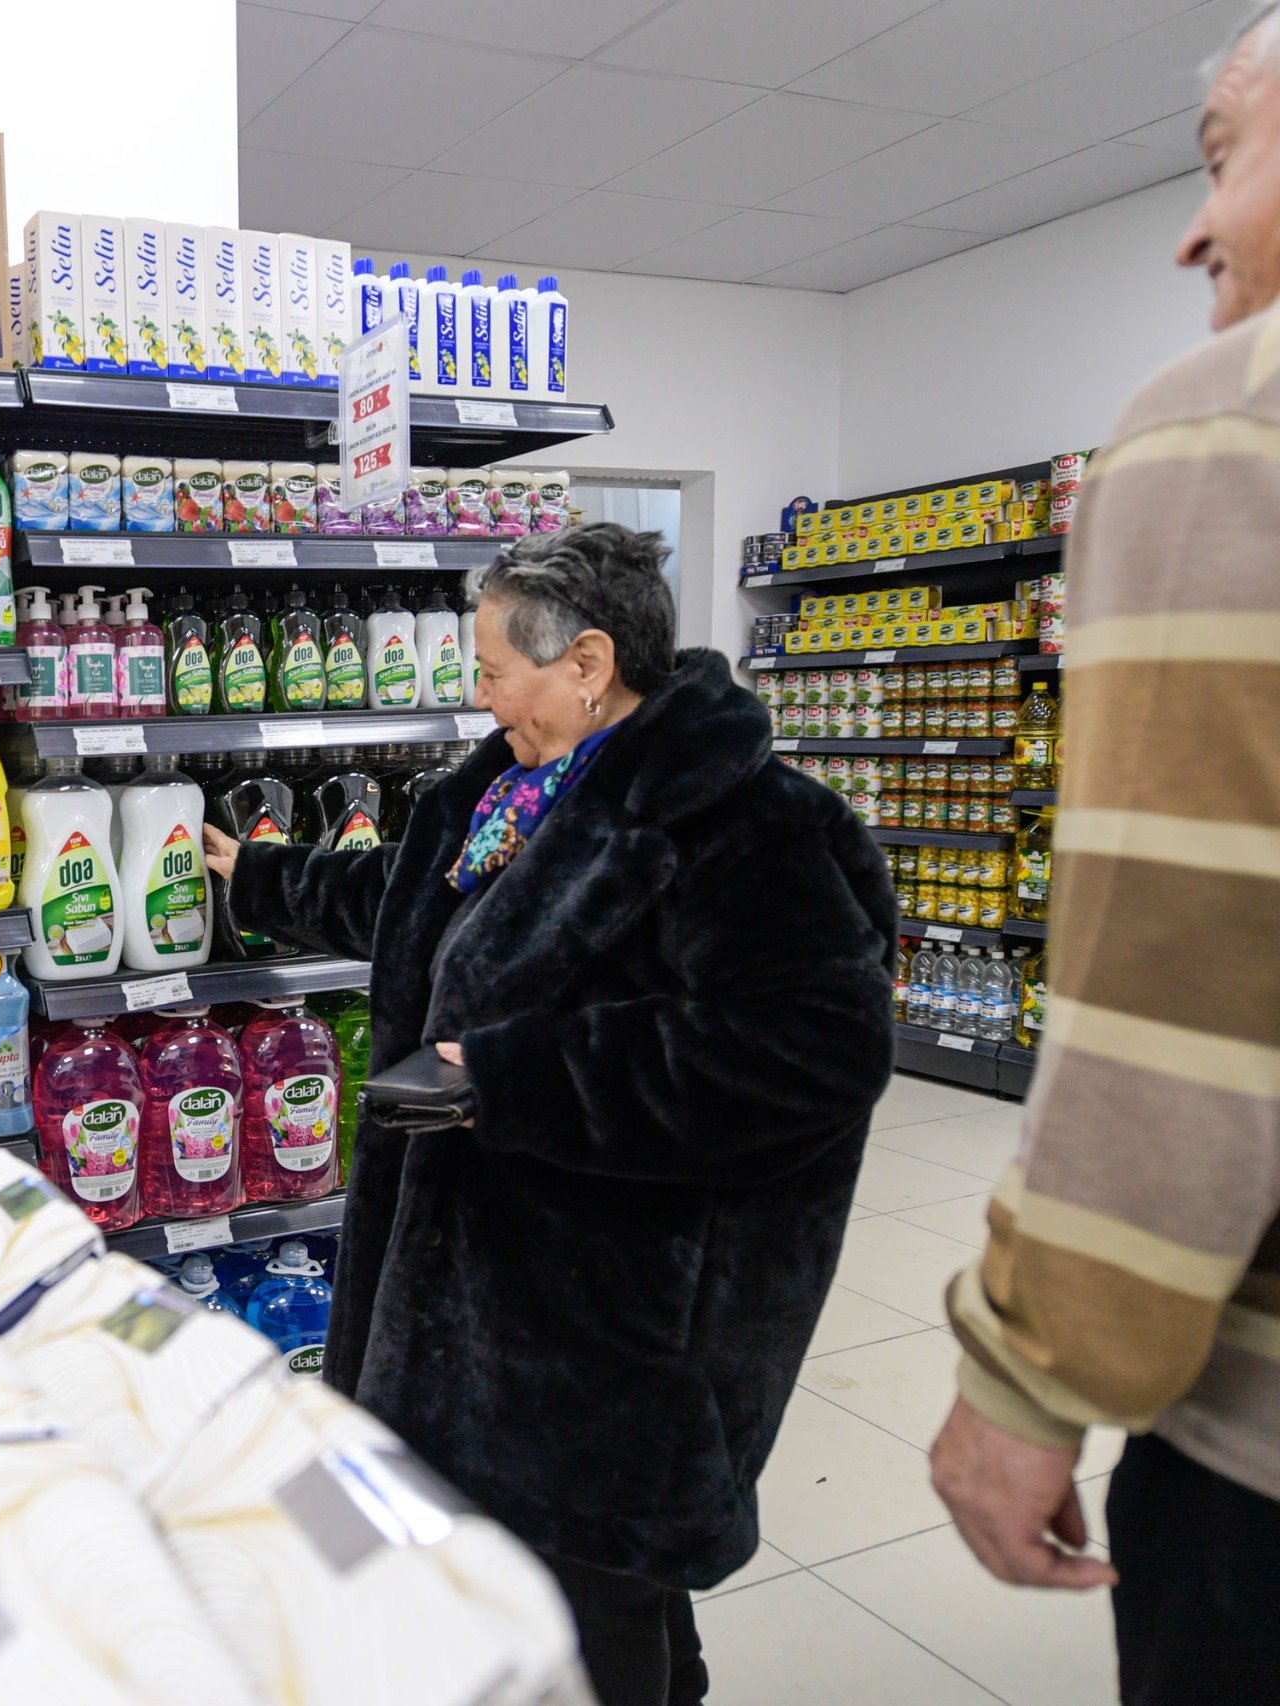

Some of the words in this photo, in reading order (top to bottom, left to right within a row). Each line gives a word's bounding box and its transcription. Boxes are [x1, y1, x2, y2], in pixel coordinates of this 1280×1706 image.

[50, 225, 74, 291] Selin
[93, 228, 117, 293] Selin
[136, 232, 158, 297] Selin
[176, 237, 197, 301] Selin
[215, 240, 236, 304] Selin
[252, 244, 273, 307] Selin
[290, 248, 310, 311] Selin
[326, 253, 346, 315] Selin
[475, 300, 490, 341] Selin
[360, 395, 374, 417] 80
[359, 451, 378, 475] 125
[1059, 456, 1076, 469] tat
[81, 467, 111, 480] dalan
[134, 470, 163, 482] dalan
[191, 475, 217, 487] dalan
[1054, 498, 1070, 510] tat
[185, 650, 203, 667] doa
[235, 649, 255, 665] doa
[294, 646, 313, 662] doa
[334, 647, 353, 663] doa
[384, 648, 404, 664] doa
[440, 647, 455, 662] doa
[59, 857, 94, 888] doa
[163, 850, 192, 878] doa
[167, 894, 194, 905] Sabun
[65, 903, 96, 915] Sabun
[284, 1082, 322, 1099] dalan
[181, 1093, 222, 1110] dalan
[289, 1105, 320, 1115] Family
[83, 1107, 123, 1125] dalan
[187, 1117, 218, 1127] Family
[89, 1131, 120, 1142] Family
